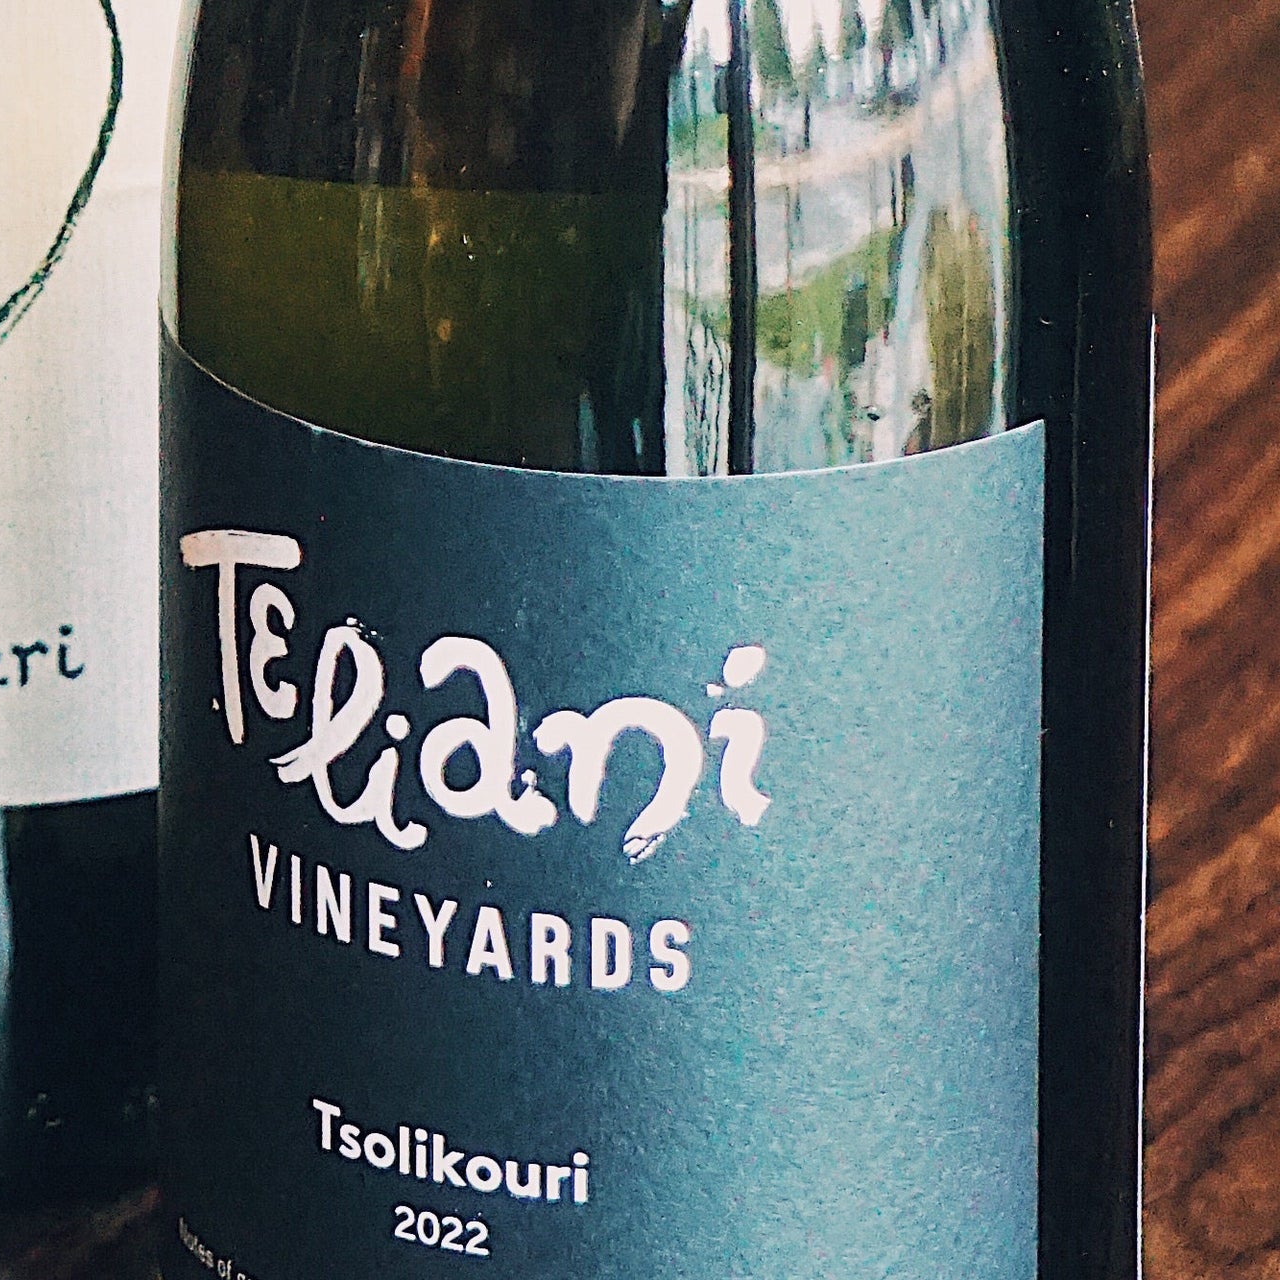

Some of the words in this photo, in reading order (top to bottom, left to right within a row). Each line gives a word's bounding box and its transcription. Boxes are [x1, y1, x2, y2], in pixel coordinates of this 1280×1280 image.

[249, 832, 691, 993] VINEYARDS
[312, 1097, 590, 1204] Tsolikouri
[393, 1205, 490, 1256] 2022
